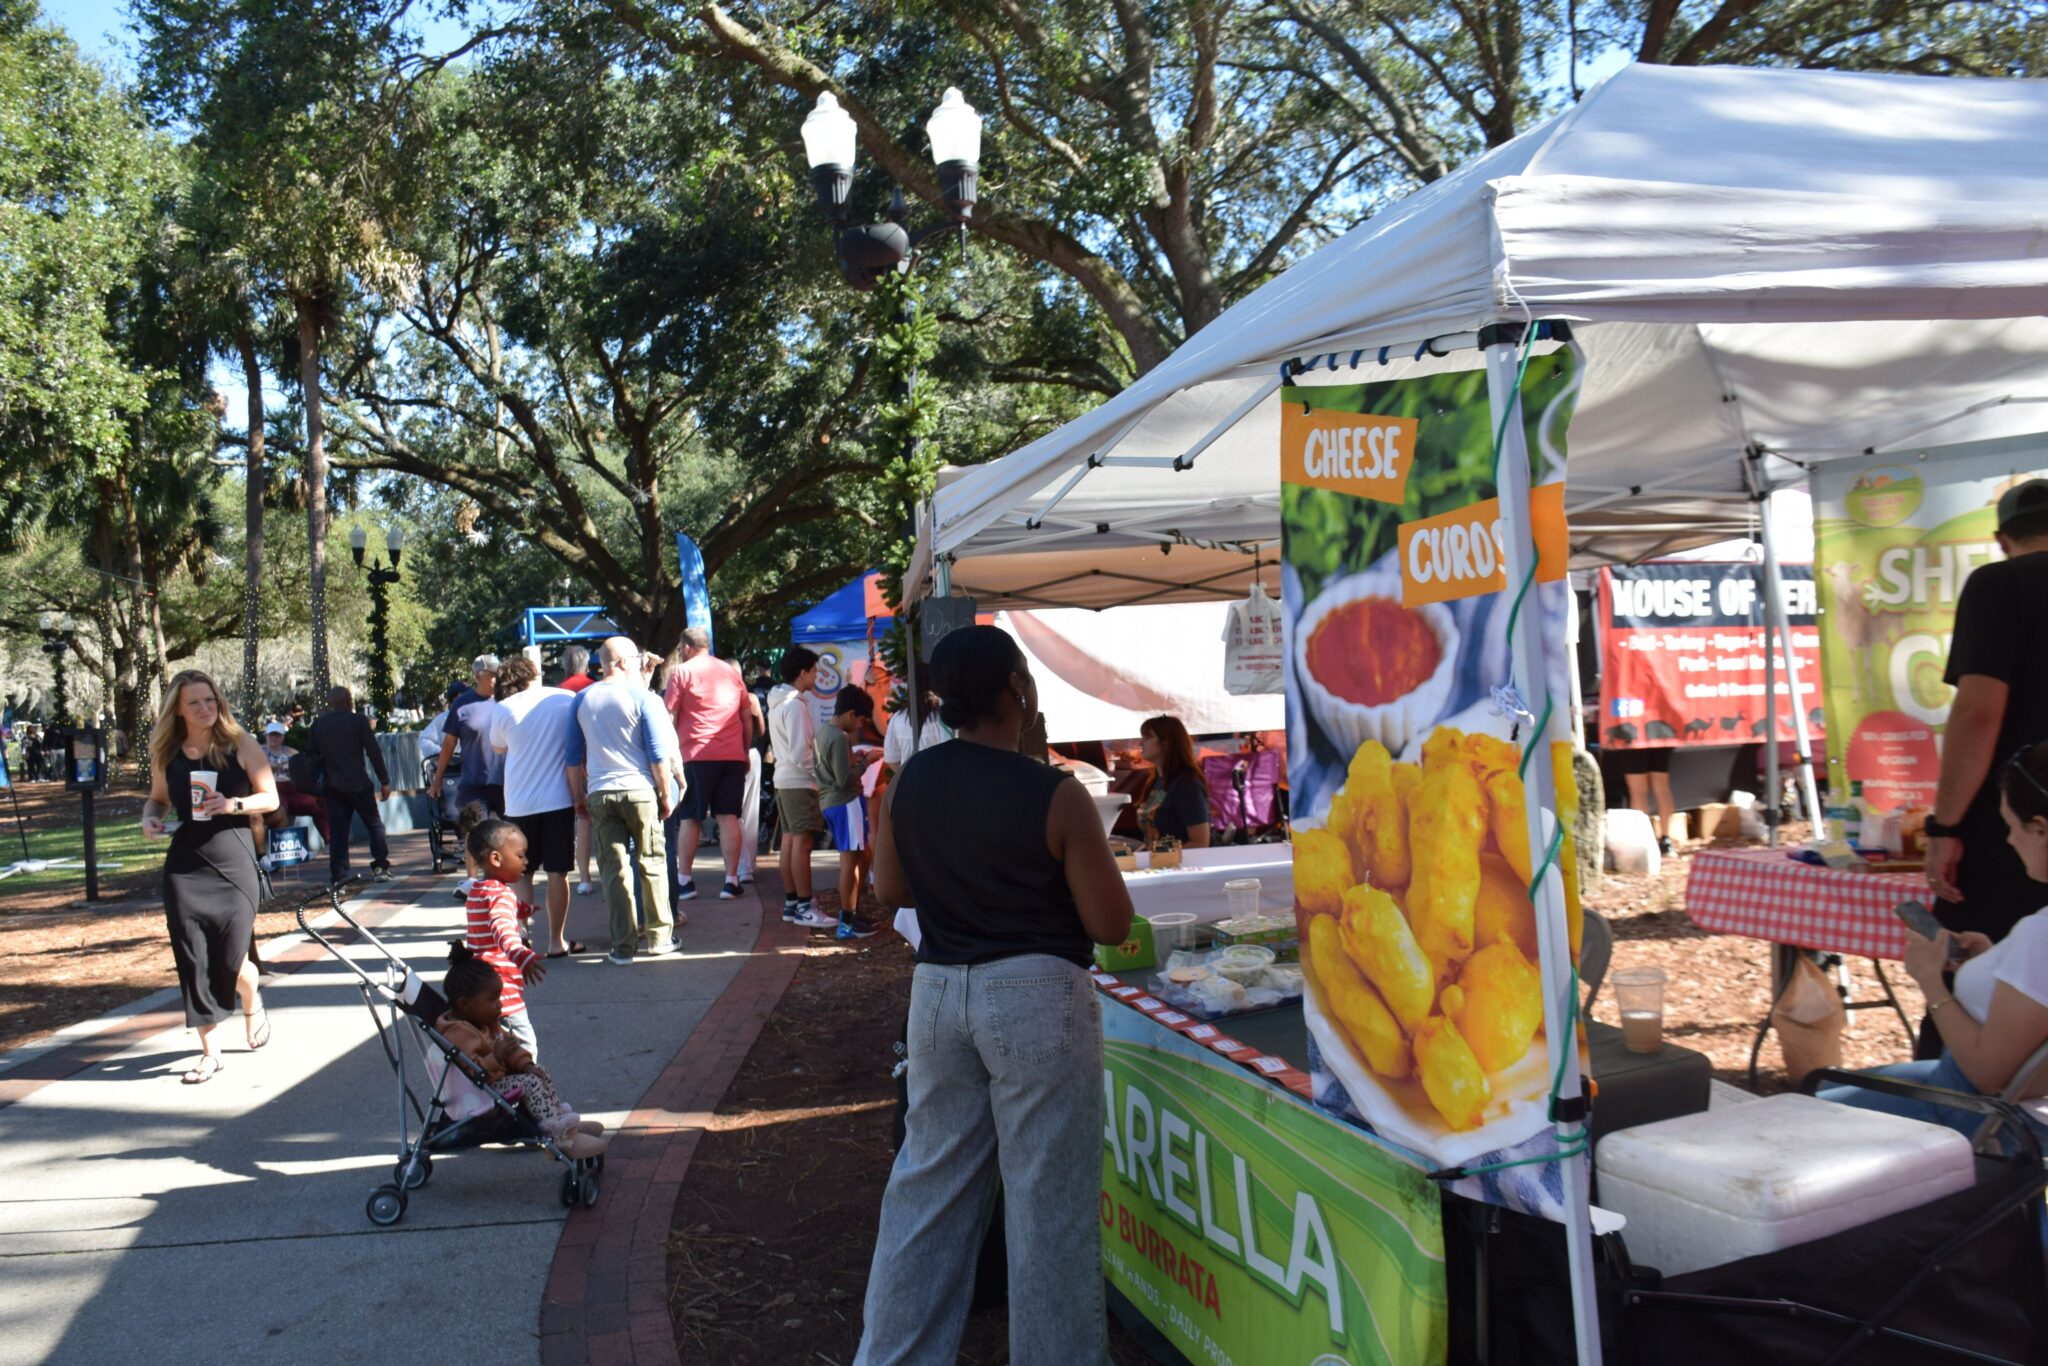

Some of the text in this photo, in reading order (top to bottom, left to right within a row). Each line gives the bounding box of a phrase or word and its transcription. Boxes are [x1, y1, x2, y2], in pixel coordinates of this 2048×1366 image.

[1304, 426, 1401, 479] CHEESE
[1878, 544, 2007, 604] SHE
[1718, 579, 1756, 617] OF
[272, 839, 301, 851] YOGA
[275, 851, 301, 859] FESTIVAL
[1118, 1202, 1221, 1320] BURRATA
[1169, 1304, 1201, 1344] DAILY
